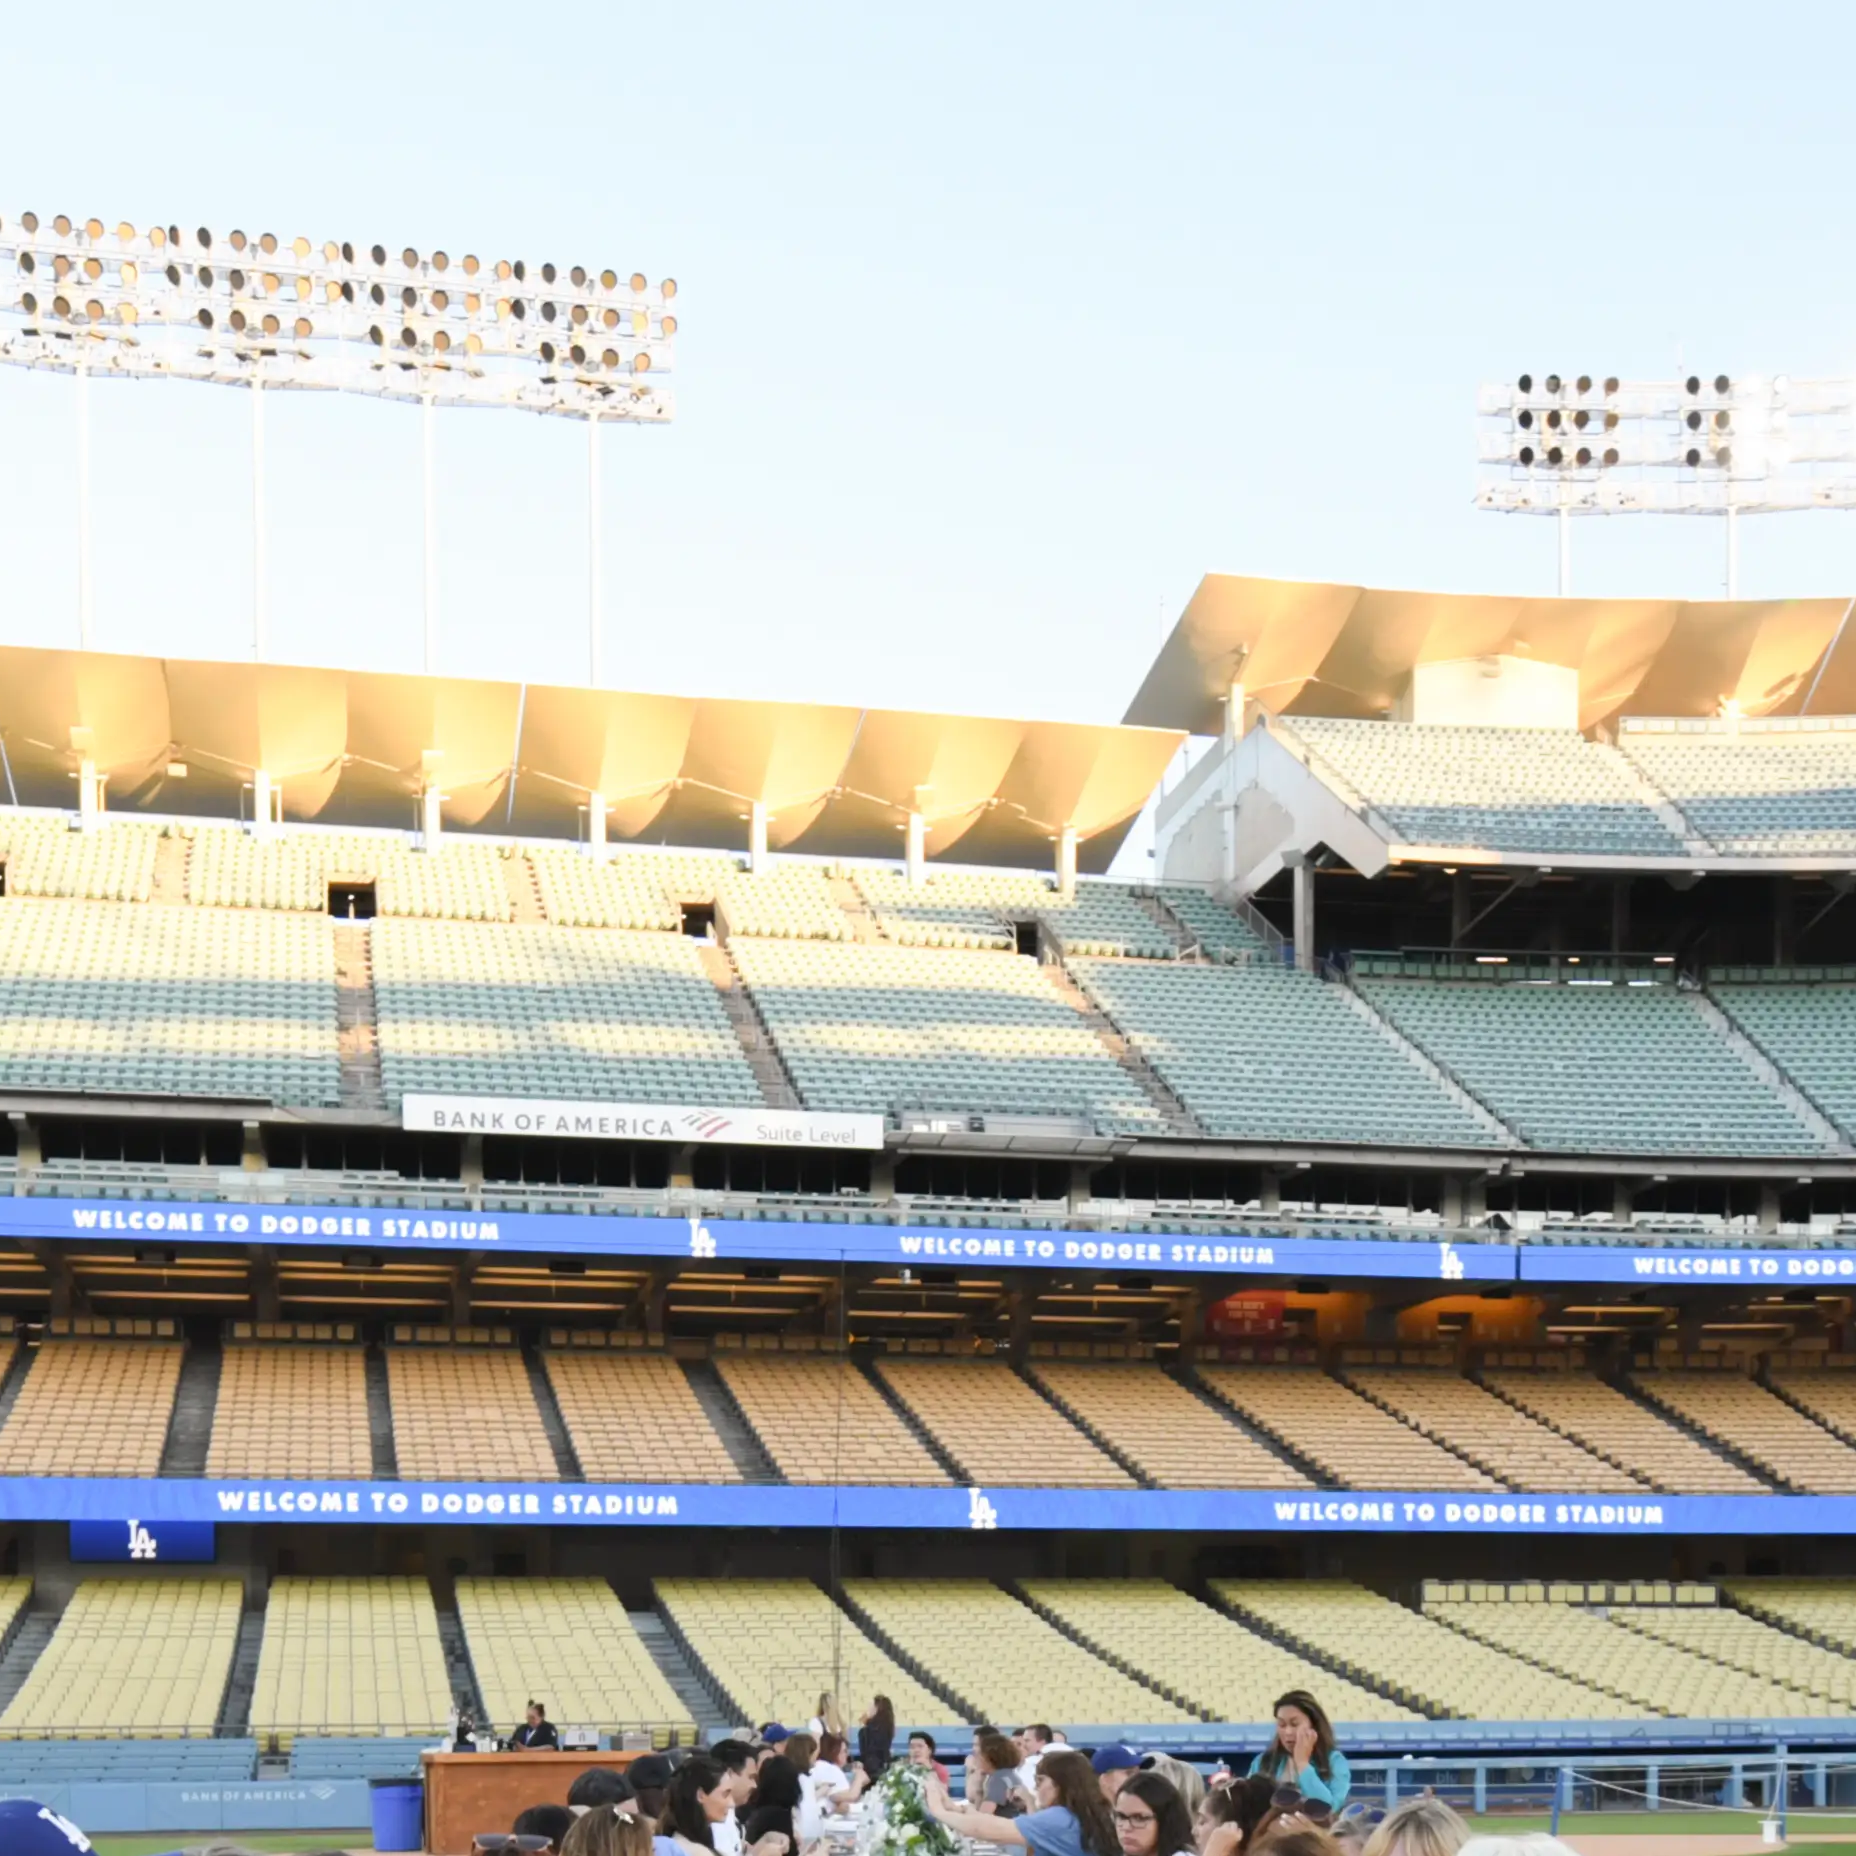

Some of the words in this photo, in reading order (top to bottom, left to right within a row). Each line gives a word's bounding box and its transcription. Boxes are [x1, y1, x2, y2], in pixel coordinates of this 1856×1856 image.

[433, 1110, 505, 1131] BANK
[514, 1114, 546, 1132] OF
[554, 1116, 674, 1138] AMERICA
[756, 1124, 803, 1143] Suite
[809, 1126, 856, 1144] Level
[73, 1209, 204, 1232] WELCOME
[214, 1213, 251, 1233] TO
[260, 1215, 372, 1238] DODGER
[382, 1219, 500, 1241] STADIUM
[899, 1235, 1015, 1257] WELCOME
[1023, 1239, 1056, 1258] TO
[1064, 1241, 1162, 1261] DODGER
[1171, 1244, 1274, 1265] STADIUM
[1633, 1257, 1741, 1276] WELCOME
[1748, 1258, 1779, 1276] TO
[217, 1491, 359, 1513] WELCOME
[370, 1492, 409, 1513] TO
[421, 1493, 540, 1514] DODGER
[553, 1494, 678, 1515] STADIUM
[1274, 1502, 1394, 1522] WELCOME
[1403, 1502, 1436, 1522] TO
[1445, 1503, 1546, 1523] DODGER
[1555, 1504, 1664, 1524] STADIUM
[128, 1519, 157, 1558] LA
[181, 1791, 219, 1802] BANK
[223, 1790, 240, 1801] OF
[244, 1789, 307, 1801] AMERICA
